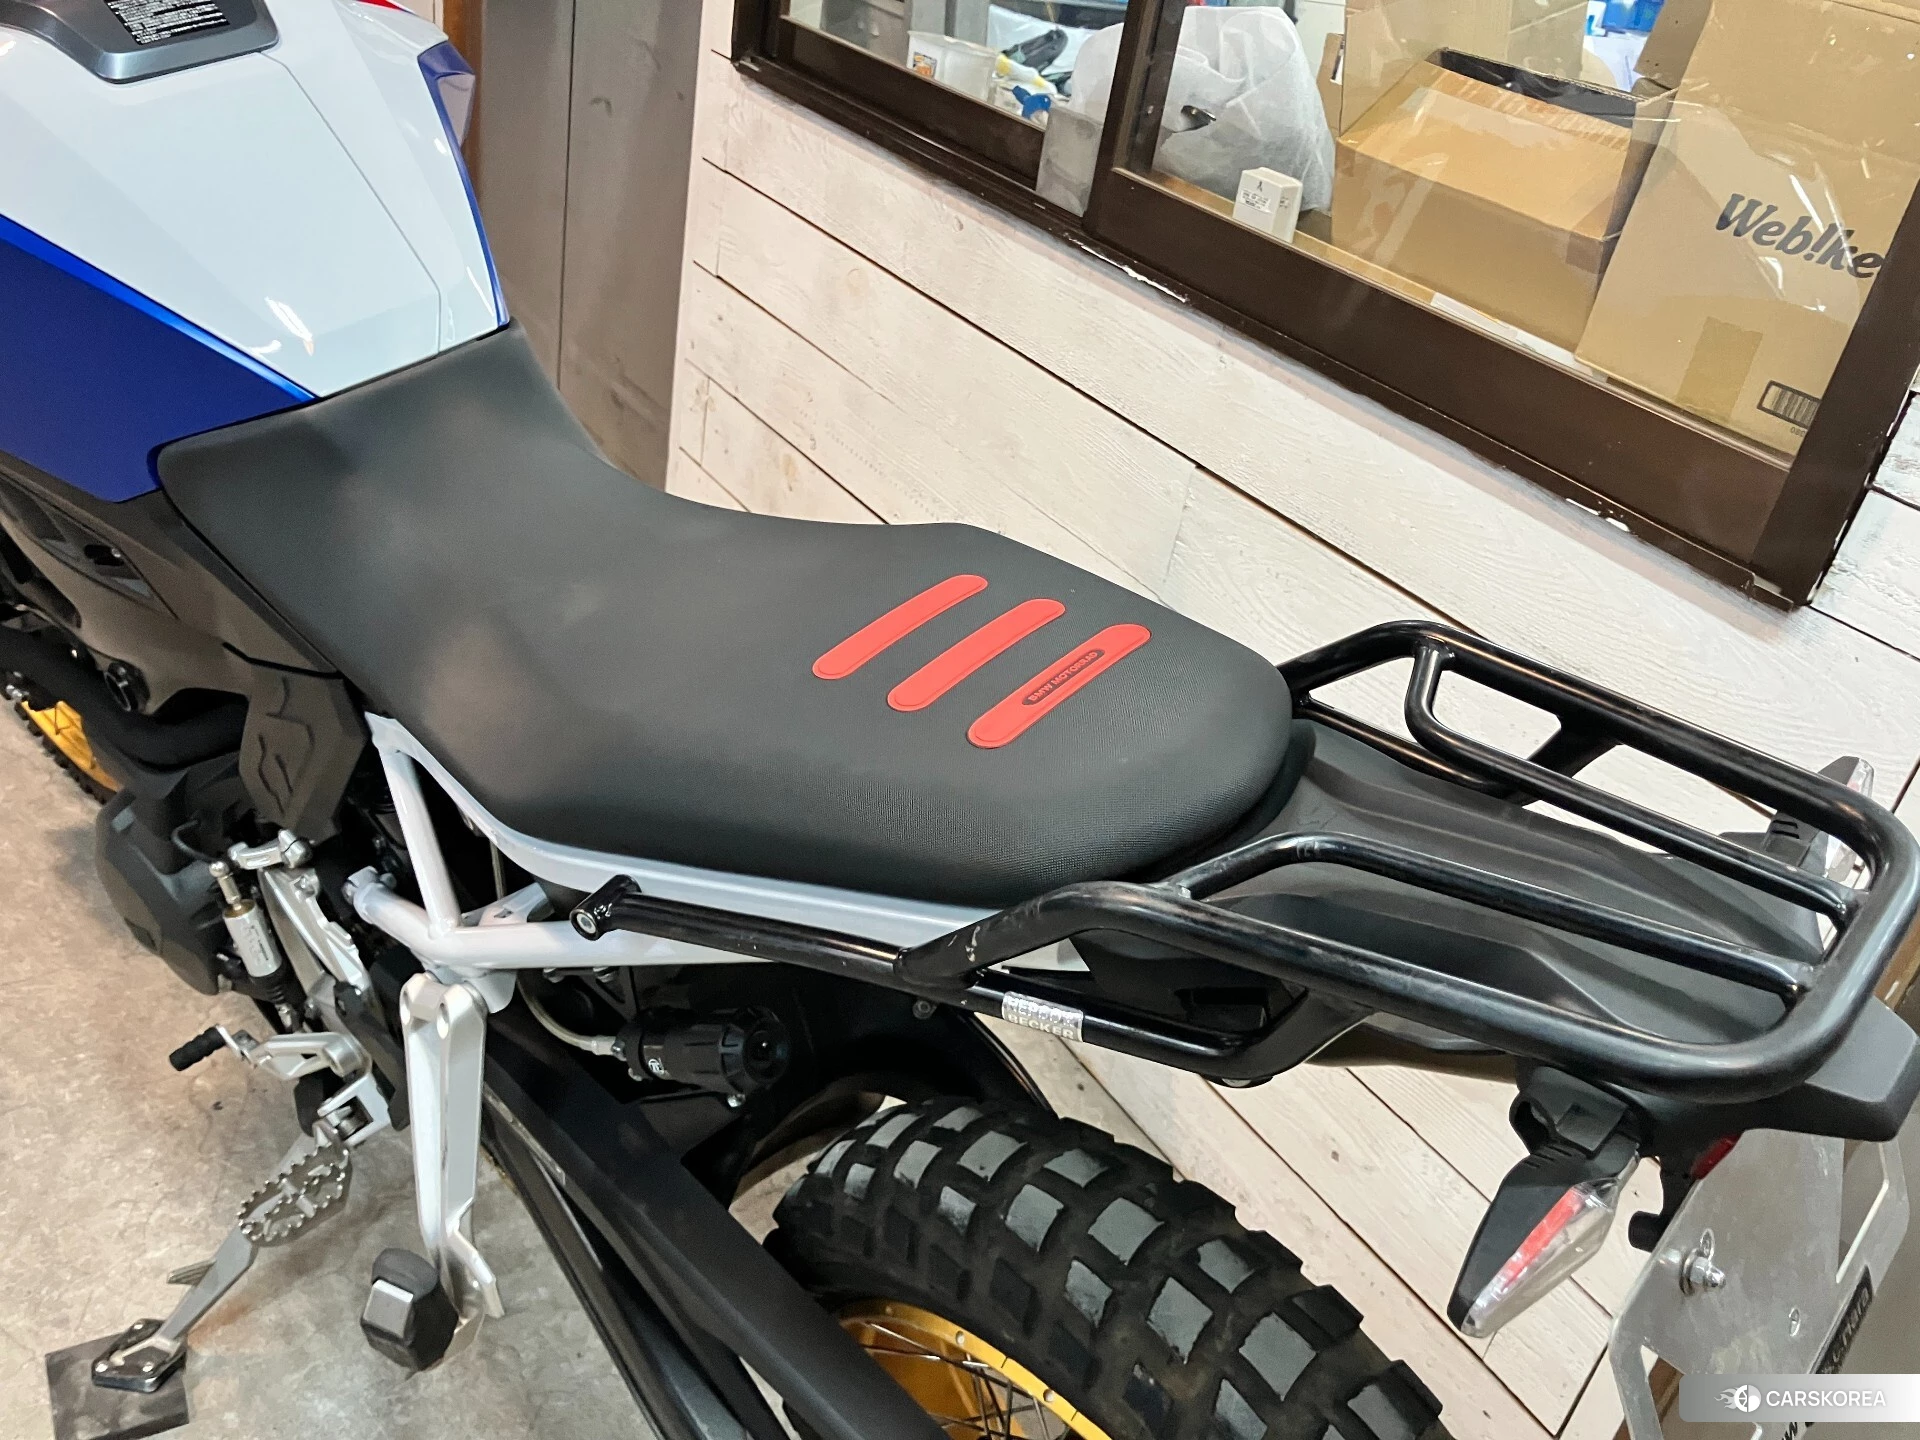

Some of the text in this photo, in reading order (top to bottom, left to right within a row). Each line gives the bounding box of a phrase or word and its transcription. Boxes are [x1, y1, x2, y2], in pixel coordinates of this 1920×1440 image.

[1027, 651, 1098, 701] BMW MOTORRAD
[1008, 1013, 1074, 1040] BECKER
